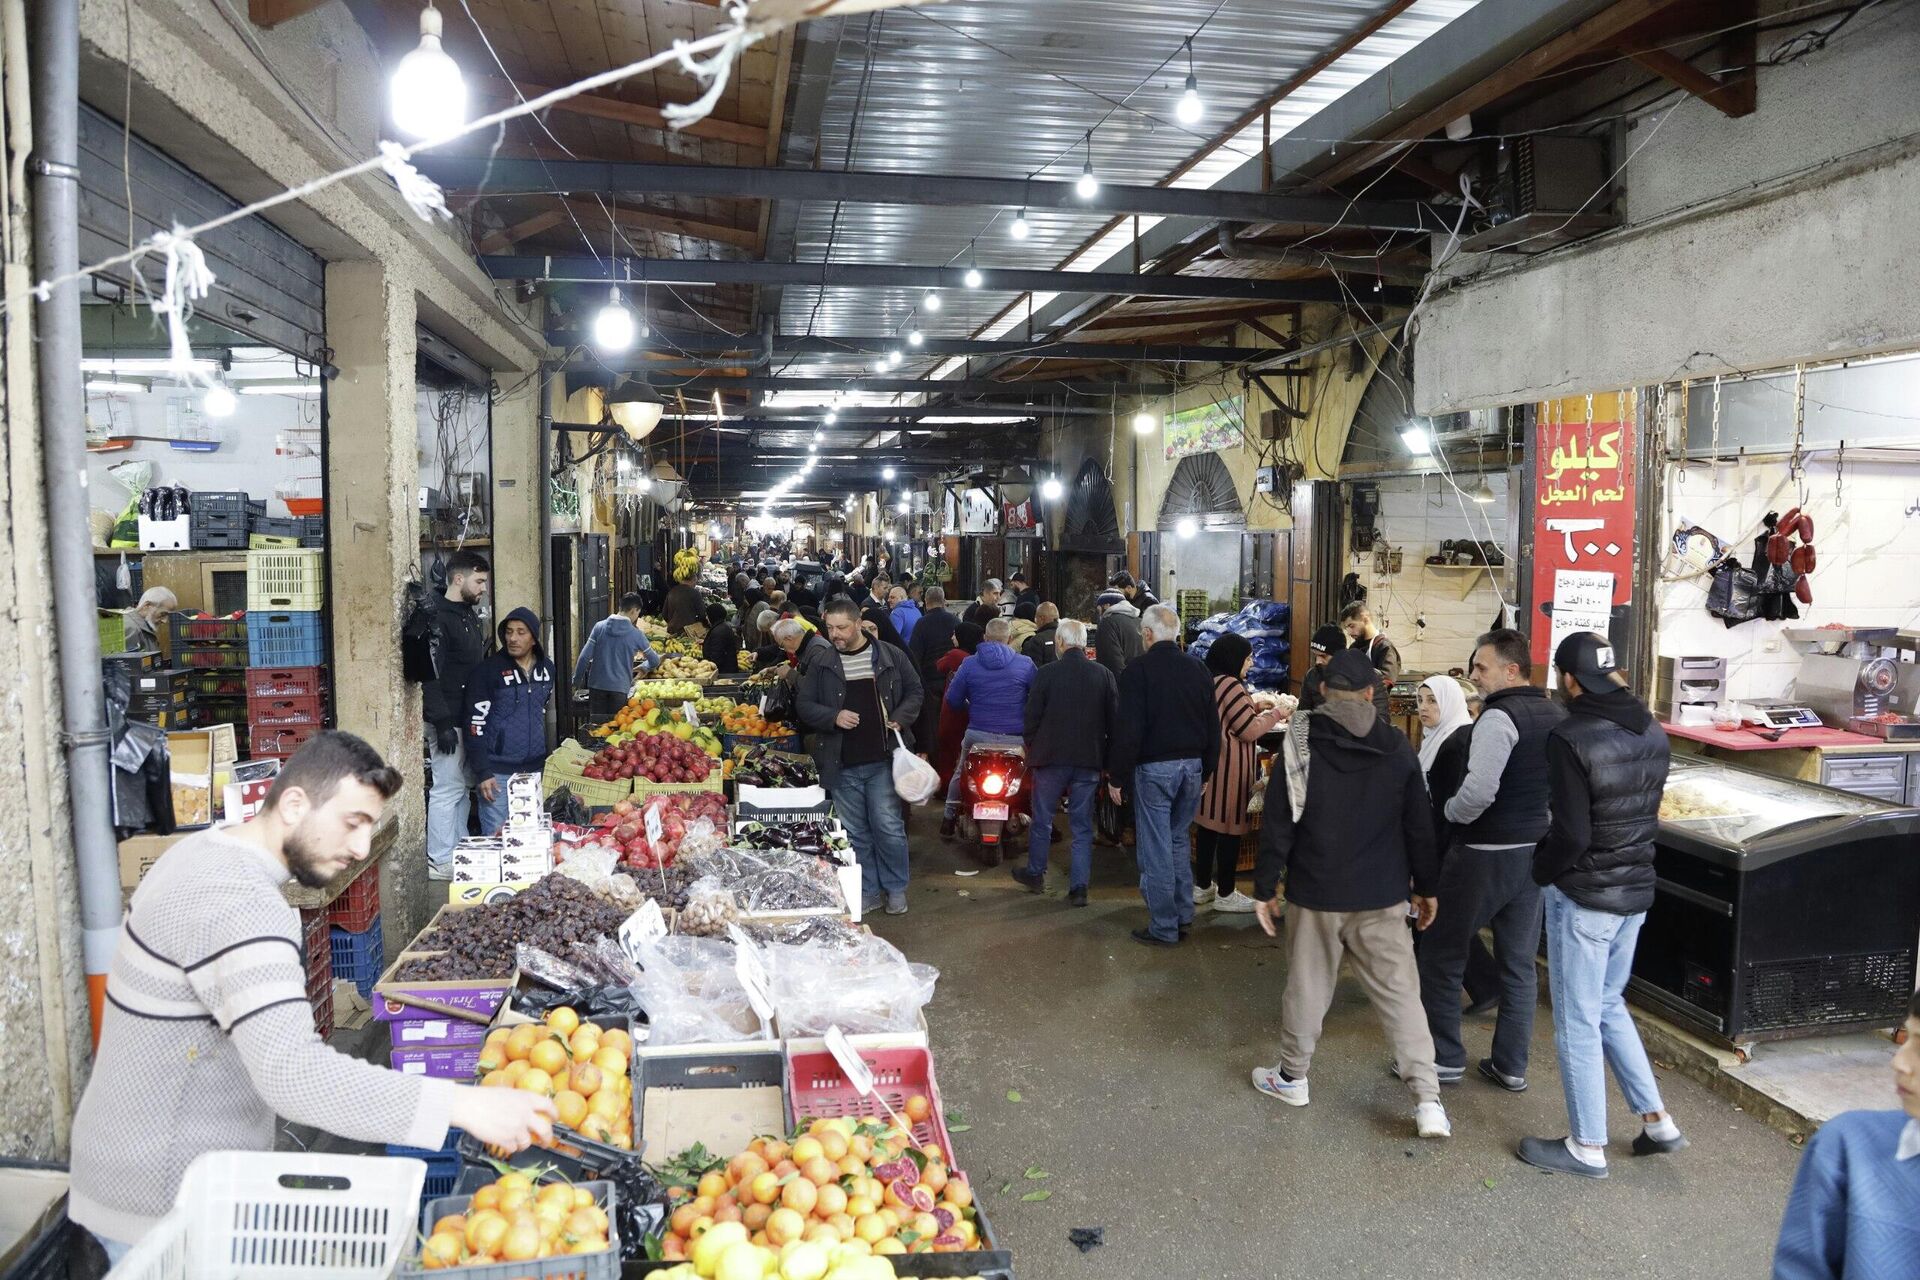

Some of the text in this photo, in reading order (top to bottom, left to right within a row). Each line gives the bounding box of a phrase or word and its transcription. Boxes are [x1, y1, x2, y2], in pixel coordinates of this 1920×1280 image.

[1544, 431, 1621, 481] كيلو
[1541, 484, 1625, 507] لحم العجل
[1558, 577, 1575, 588] دجاج
[1597, 579, 1610, 591] كيلو
[1555, 618, 1572, 629] دجاج
[1592, 619, 1606, 631] كيلو
[470, 700, 491, 736] FILA
